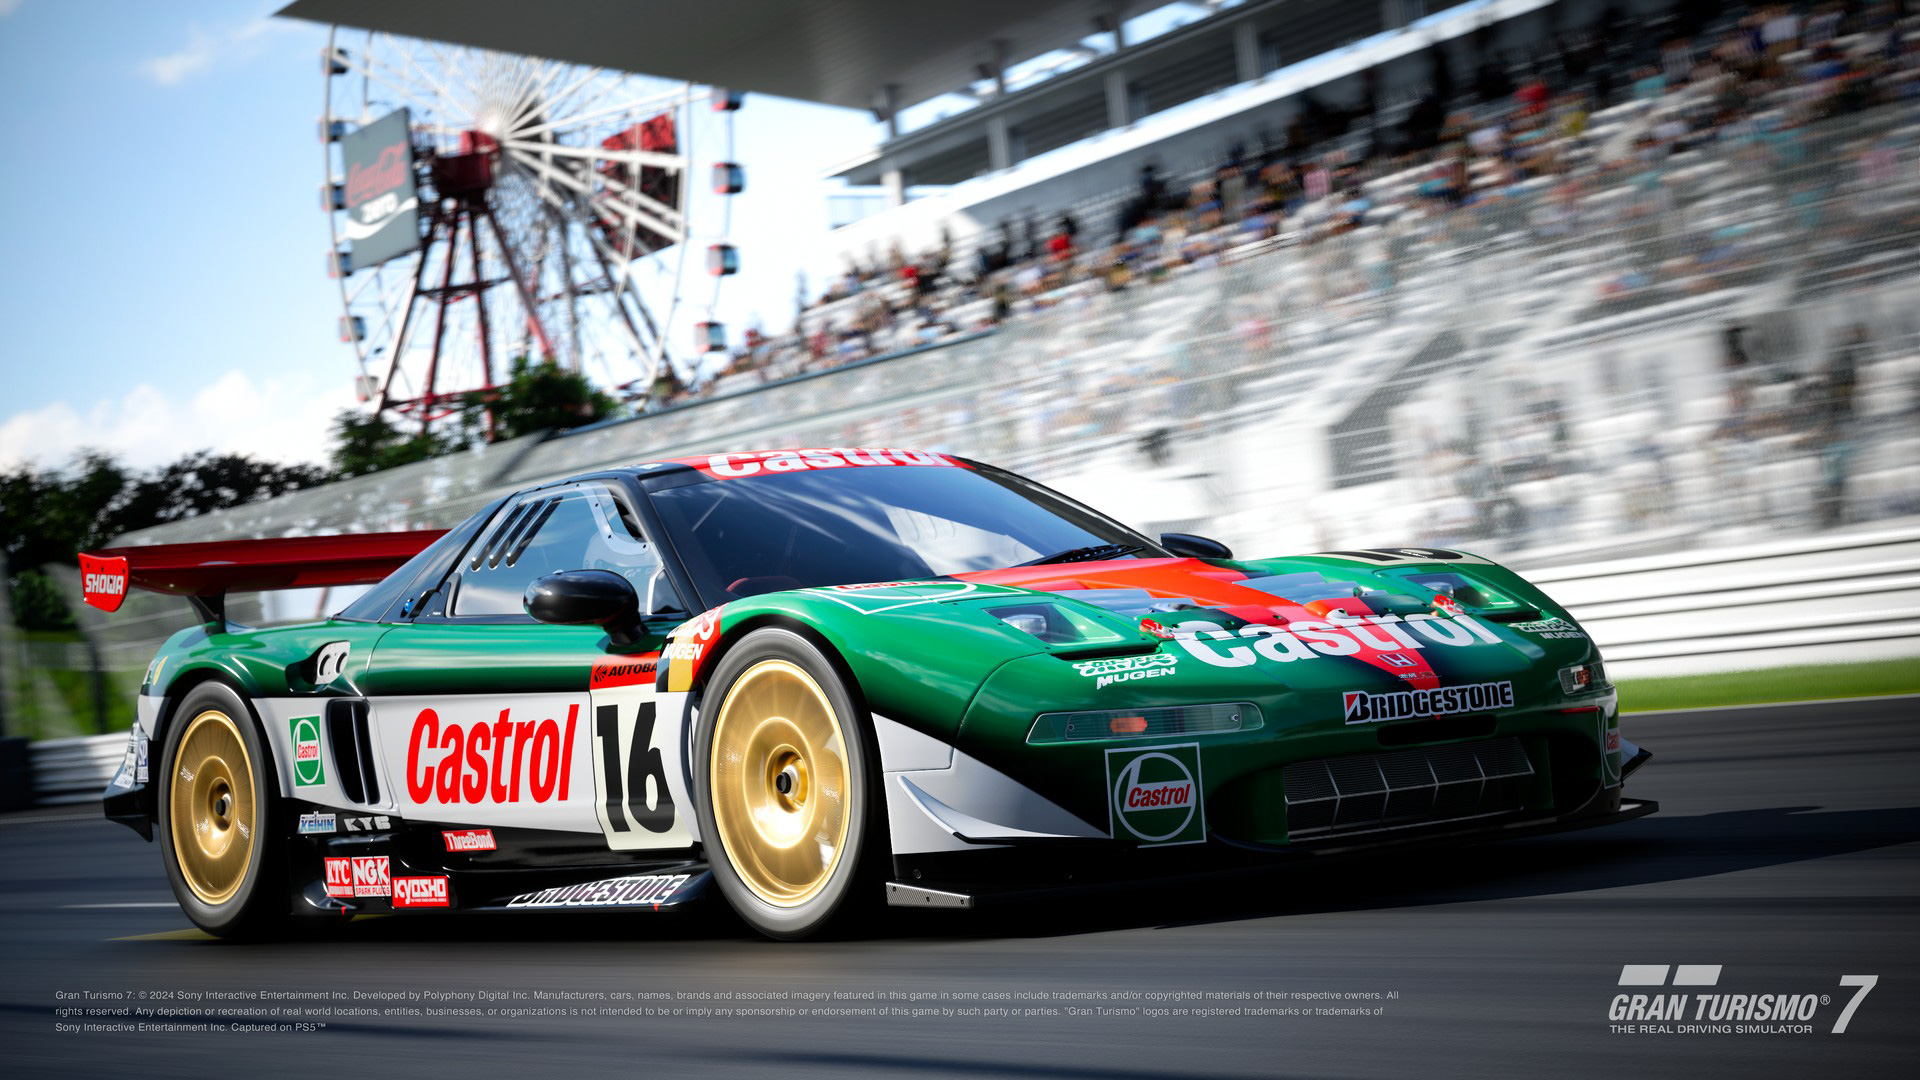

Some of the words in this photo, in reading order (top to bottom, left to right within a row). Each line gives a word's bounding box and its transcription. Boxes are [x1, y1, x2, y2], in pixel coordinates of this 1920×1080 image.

[85, 573, 125, 595] SHOWA
[1174, 608, 1503, 667] Castrol
[660, 643, 704, 661] MUGEN
[1096, 667, 1176, 690] MUGEN
[1345, 683, 1512, 723] BRIDGESTONE
[297, 743, 319, 759] Castrol
[406, 704, 580, 804] Castrol
[596, 701, 676, 834] 16
[1127, 783, 1191, 808] Castrol
[301, 818, 335, 832] KEIHIN
[343, 816, 392, 832] KYB
[444, 831, 495, 850] ThreeBond
[326, 859, 351, 885] KTC
[352, 858, 390, 886] NGK
[355, 887, 372, 896] SPARK
[393, 878, 447, 905] KYOSHO
